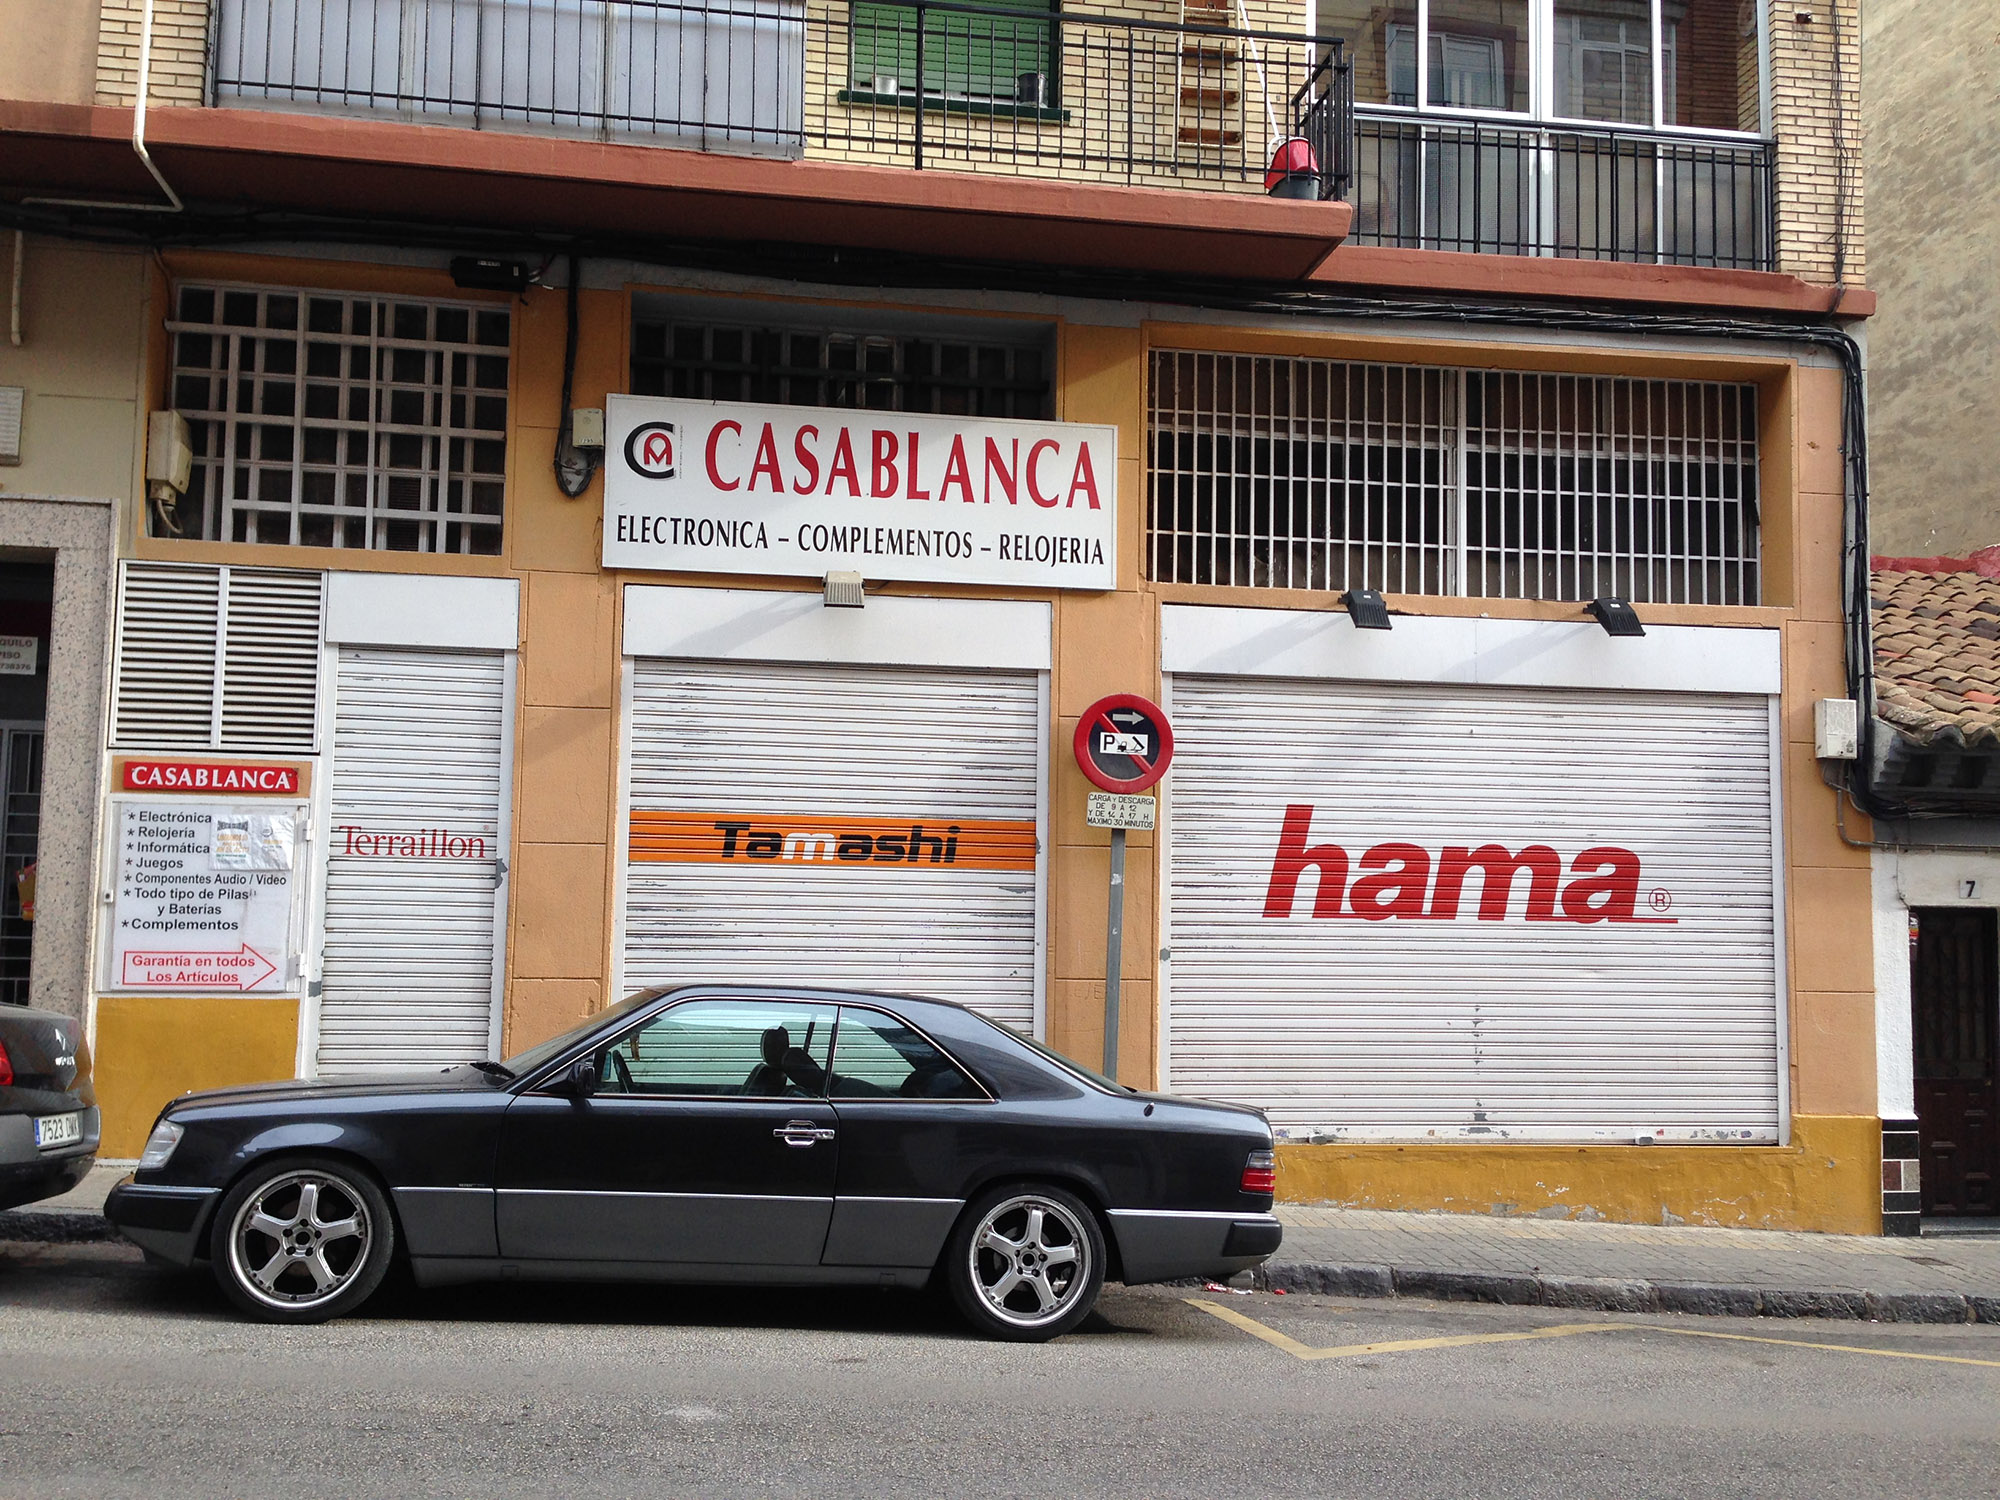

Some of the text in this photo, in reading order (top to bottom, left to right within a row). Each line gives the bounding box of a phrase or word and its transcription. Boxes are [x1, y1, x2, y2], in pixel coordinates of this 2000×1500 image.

[705, 419, 1101, 510] CASABLANCA
[616, 515, 768, 549] ELECTRONICA
[798, 524, 972, 559] COMPLEMENTOS
[999, 536, 1104, 566] RELOJERIA
[131, 766, 291, 790] CASABLANCA
[1088, 794, 1111, 802] CARGA
[1118, 796, 1154, 805] DESCARGA
[139, 811, 212, 823] Electrónica
[1114, 818, 1123, 826] 30
[1124, 819, 1154, 828] MINUTOS
[138, 826, 195, 840] Relojería
[137, 842, 210, 853] Informática
[338, 825, 487, 858] Terraillon
[714, 820, 961, 863] Tamashi
[136, 857, 184, 871] Juegos
[1262, 804, 1642, 924] hama
[135, 872, 212, 886] Componentes
[214, 874, 247, 885] Audio
[134, 888, 249, 900] Todo tipo de Pilas
[1965, 880, 1976, 897] 7
[157, 904, 222, 916] y Baterías
[131, 918, 239, 932] Complementos
[132, 955, 255, 967] Garantía en todos
[147, 971, 239, 983] Los Artículos
[42, 1118, 64, 1142] 7523
